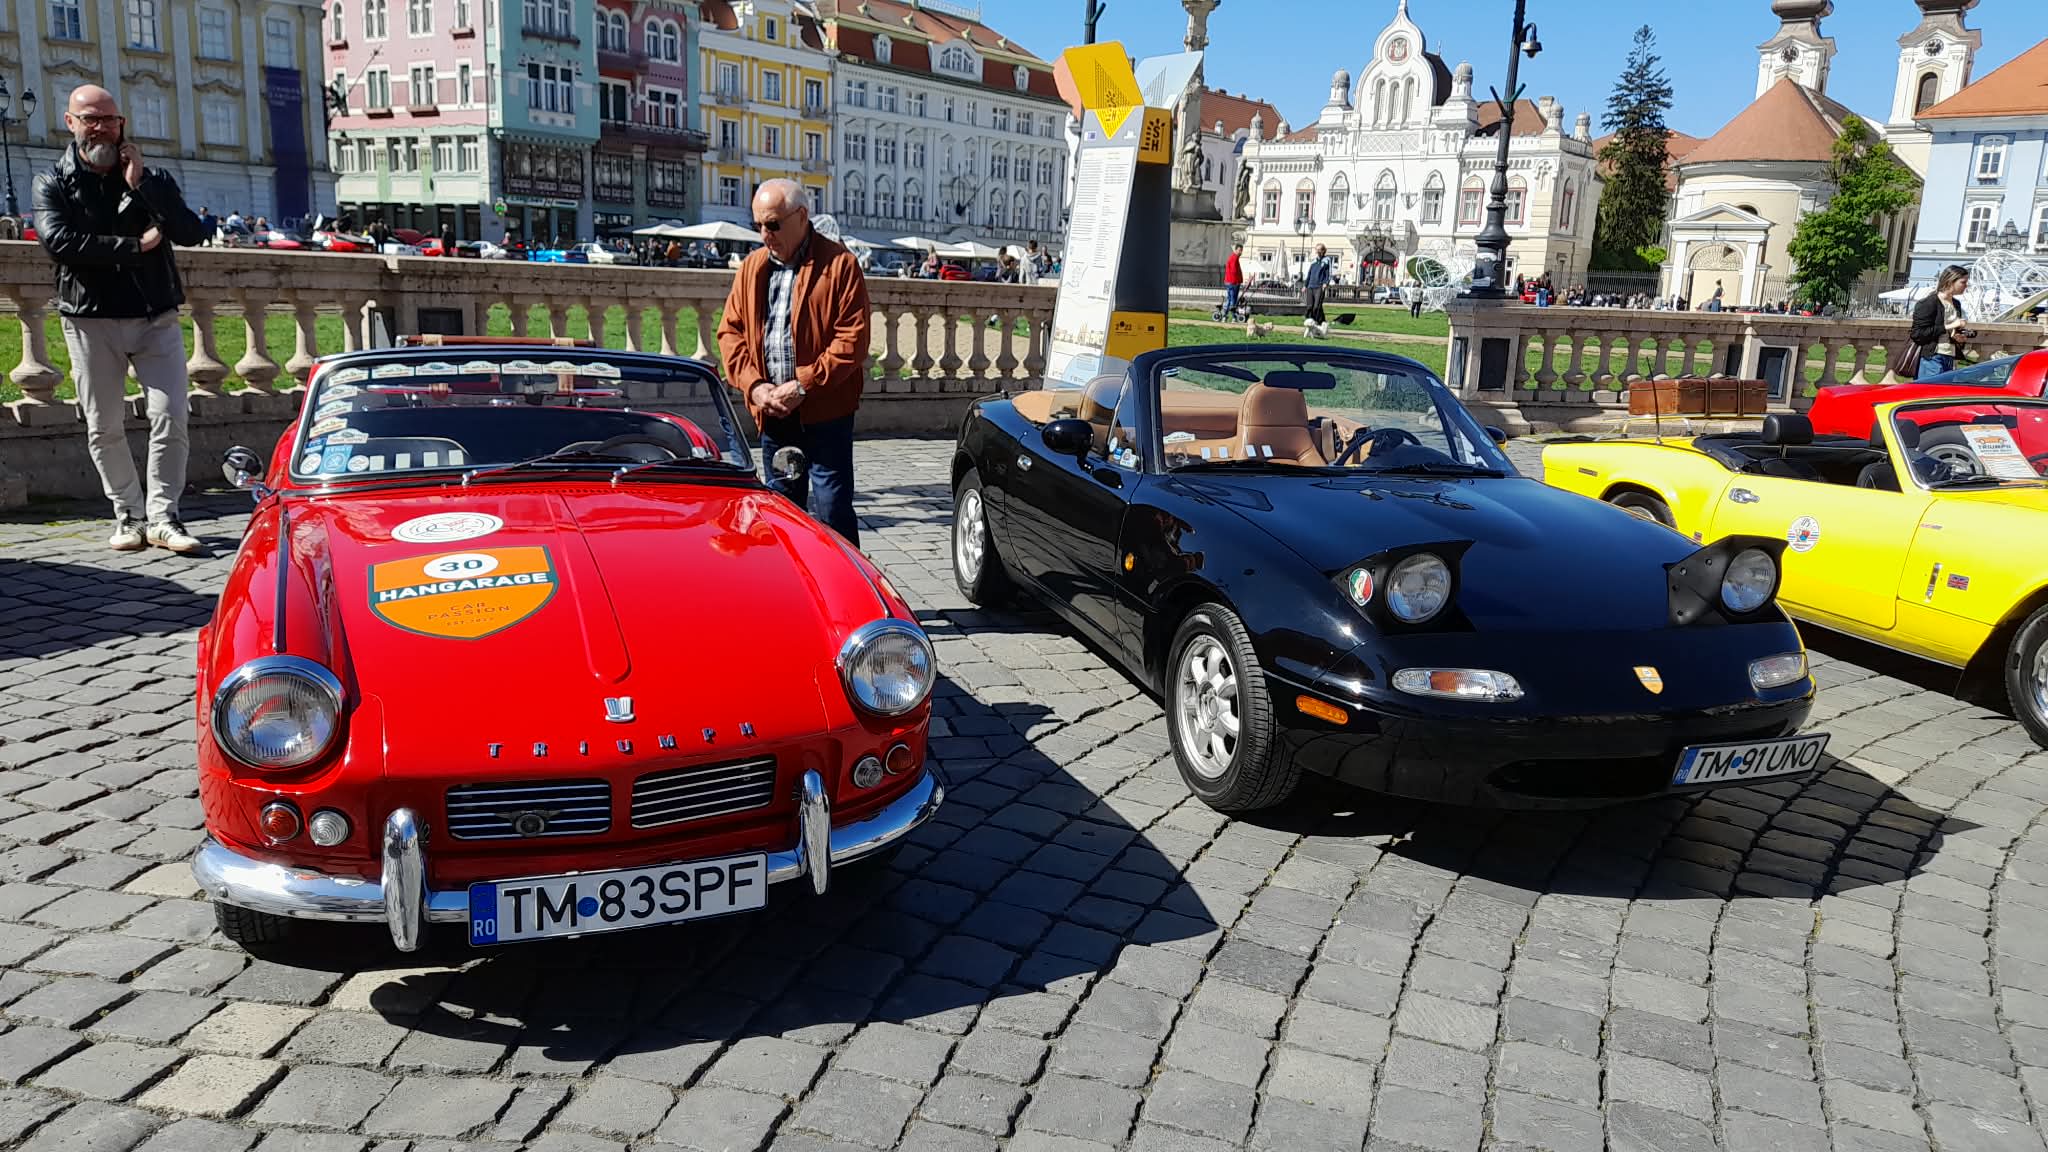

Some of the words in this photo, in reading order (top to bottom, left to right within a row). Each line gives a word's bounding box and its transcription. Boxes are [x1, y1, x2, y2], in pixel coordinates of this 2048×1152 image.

[439, 559, 483, 572] 30
[379, 572, 549, 602] HANGARAGE
[428, 605, 510, 620] PASSION
[450, 602, 486, 611] CAR
[488, 721, 757, 758] TRIUMPH
[473, 917, 496, 937] RO
